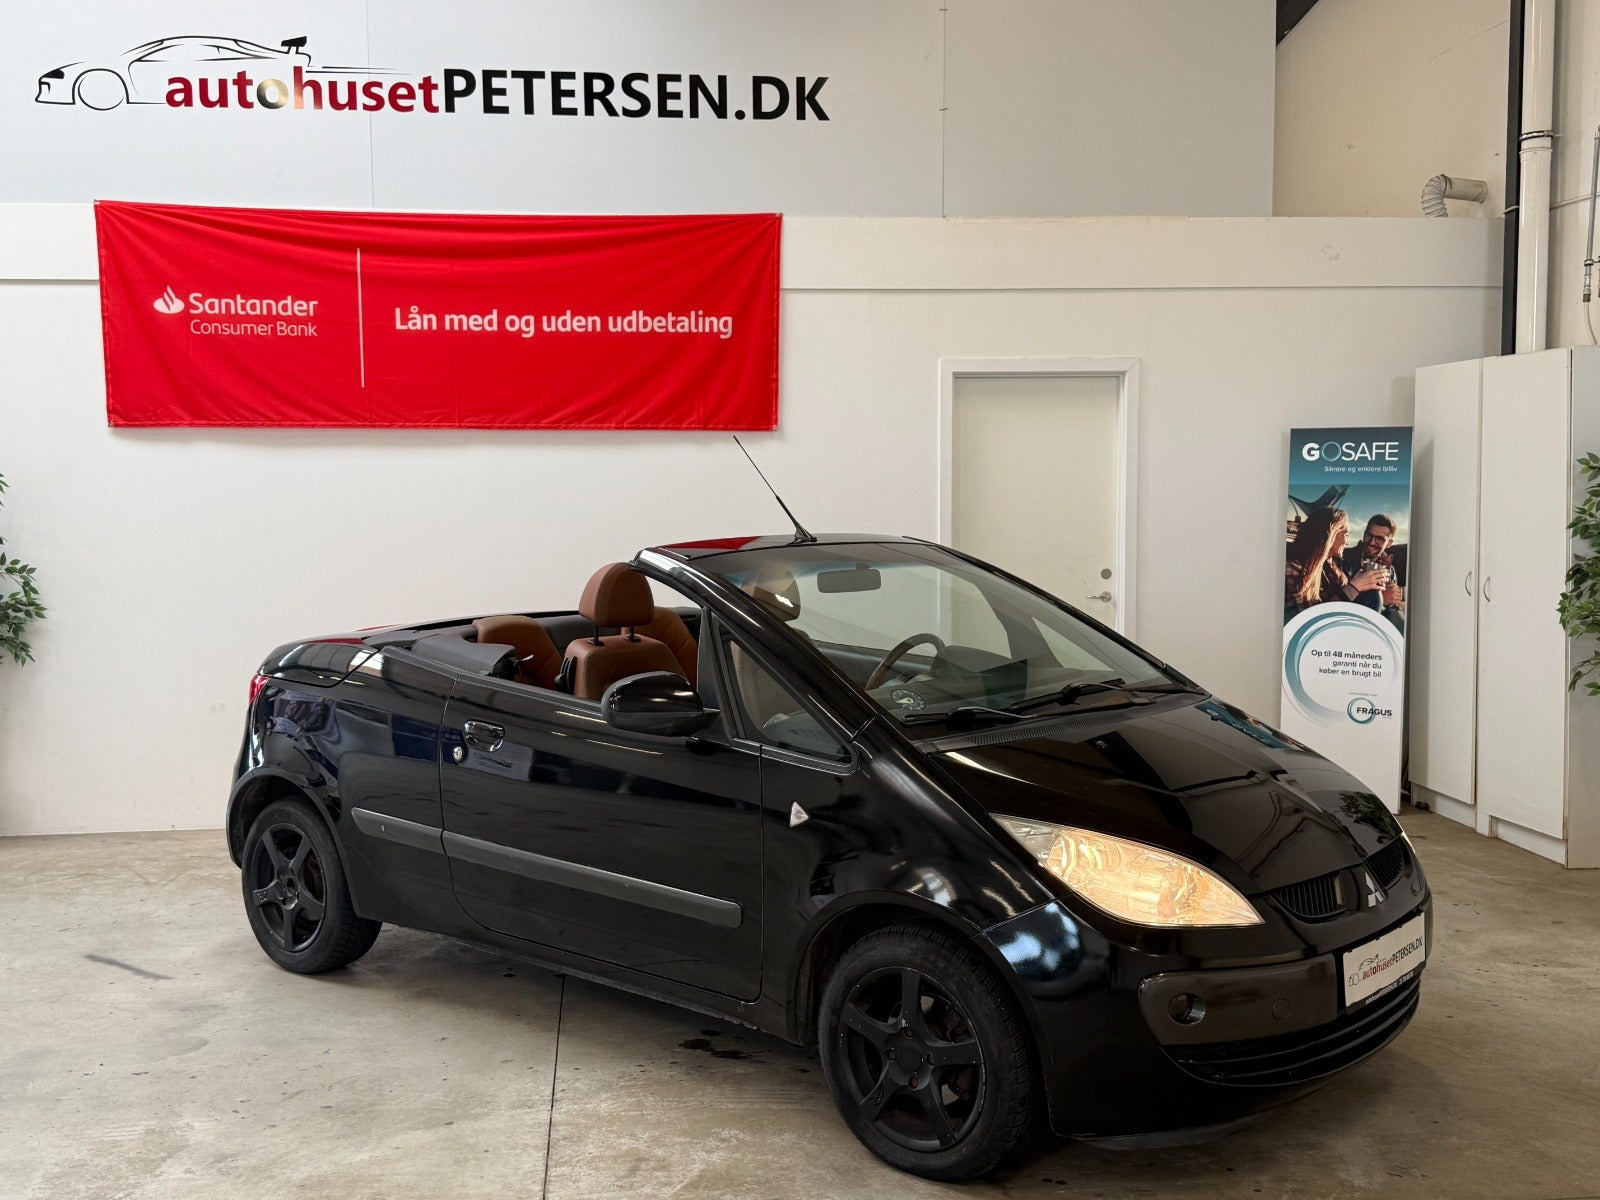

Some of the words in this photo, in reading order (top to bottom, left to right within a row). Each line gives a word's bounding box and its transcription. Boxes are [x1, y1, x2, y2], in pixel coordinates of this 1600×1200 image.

[164, 66, 830, 122] autohusetPETERSEN.DK
[189, 293, 318, 317] Santander
[190, 319, 274, 336] Consumer
[276, 321, 318, 336] Bank
[395, 305, 437, 332] Lån
[444, 309, 497, 332] med
[505, 314, 535, 338] og
[542, 310, 601, 333] uden
[608, 310, 733, 339] udbetaling
[1302, 442, 1399, 461] GOSAFE
[1311, 649, 1323, 657] Op
[1344, 652, 1382, 660] måneders
[1318, 667, 1339, 675] køber
[1352, 669, 1371, 678] brugt
[1373, 670, 1382, 678] bil
[1332, 660, 1357, 668] garanti
[1356, 707, 1393, 717] FRAGUS
